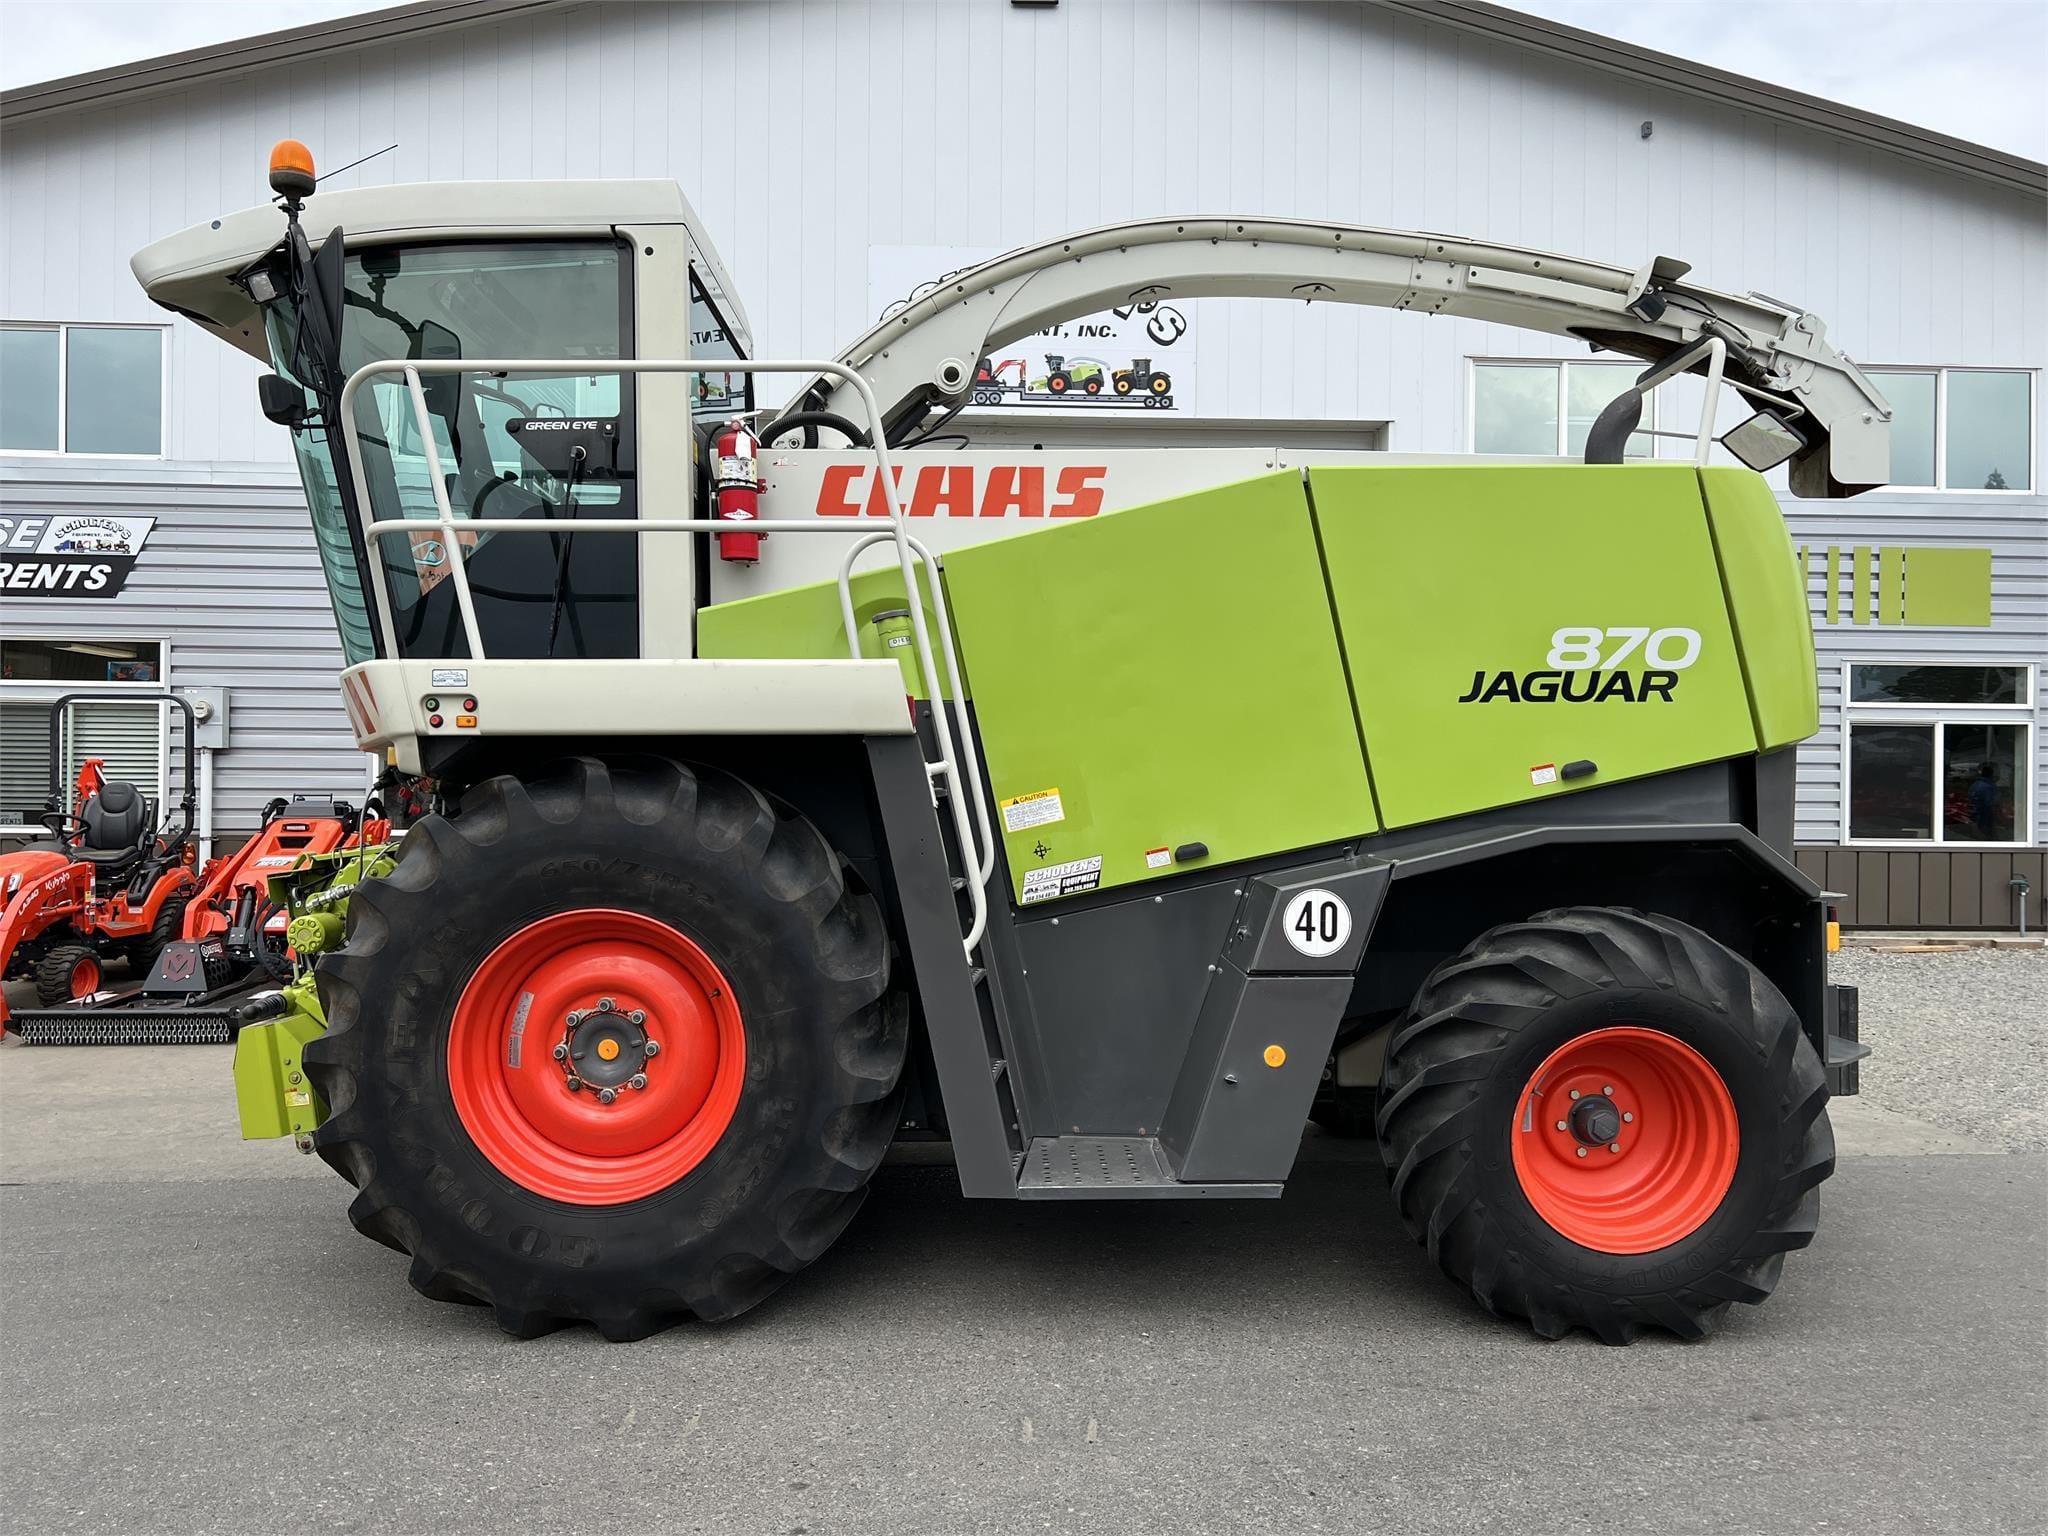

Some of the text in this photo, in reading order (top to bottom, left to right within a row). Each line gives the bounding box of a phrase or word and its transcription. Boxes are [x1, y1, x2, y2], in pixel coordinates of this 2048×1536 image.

[1035, 325, 1117, 338] NT, INC.
[525, 421, 598, 431] GREEN EYE
[815, 465, 1108, 517] CLAAS
[55, 518, 132, 540] SCHOLTEN'S
[1546, 627, 1702, 670] 870
[1458, 671, 1679, 703] JAGUAR
[1019, 792, 1048, 803] CAUTION
[45, 872, 71, 890] Kubota
[1025, 858, 1100, 884] SCHOLTEN'S
[1062, 872, 1099, 887] EQUIPMENT
[1295, 901, 1338, 942] 40
